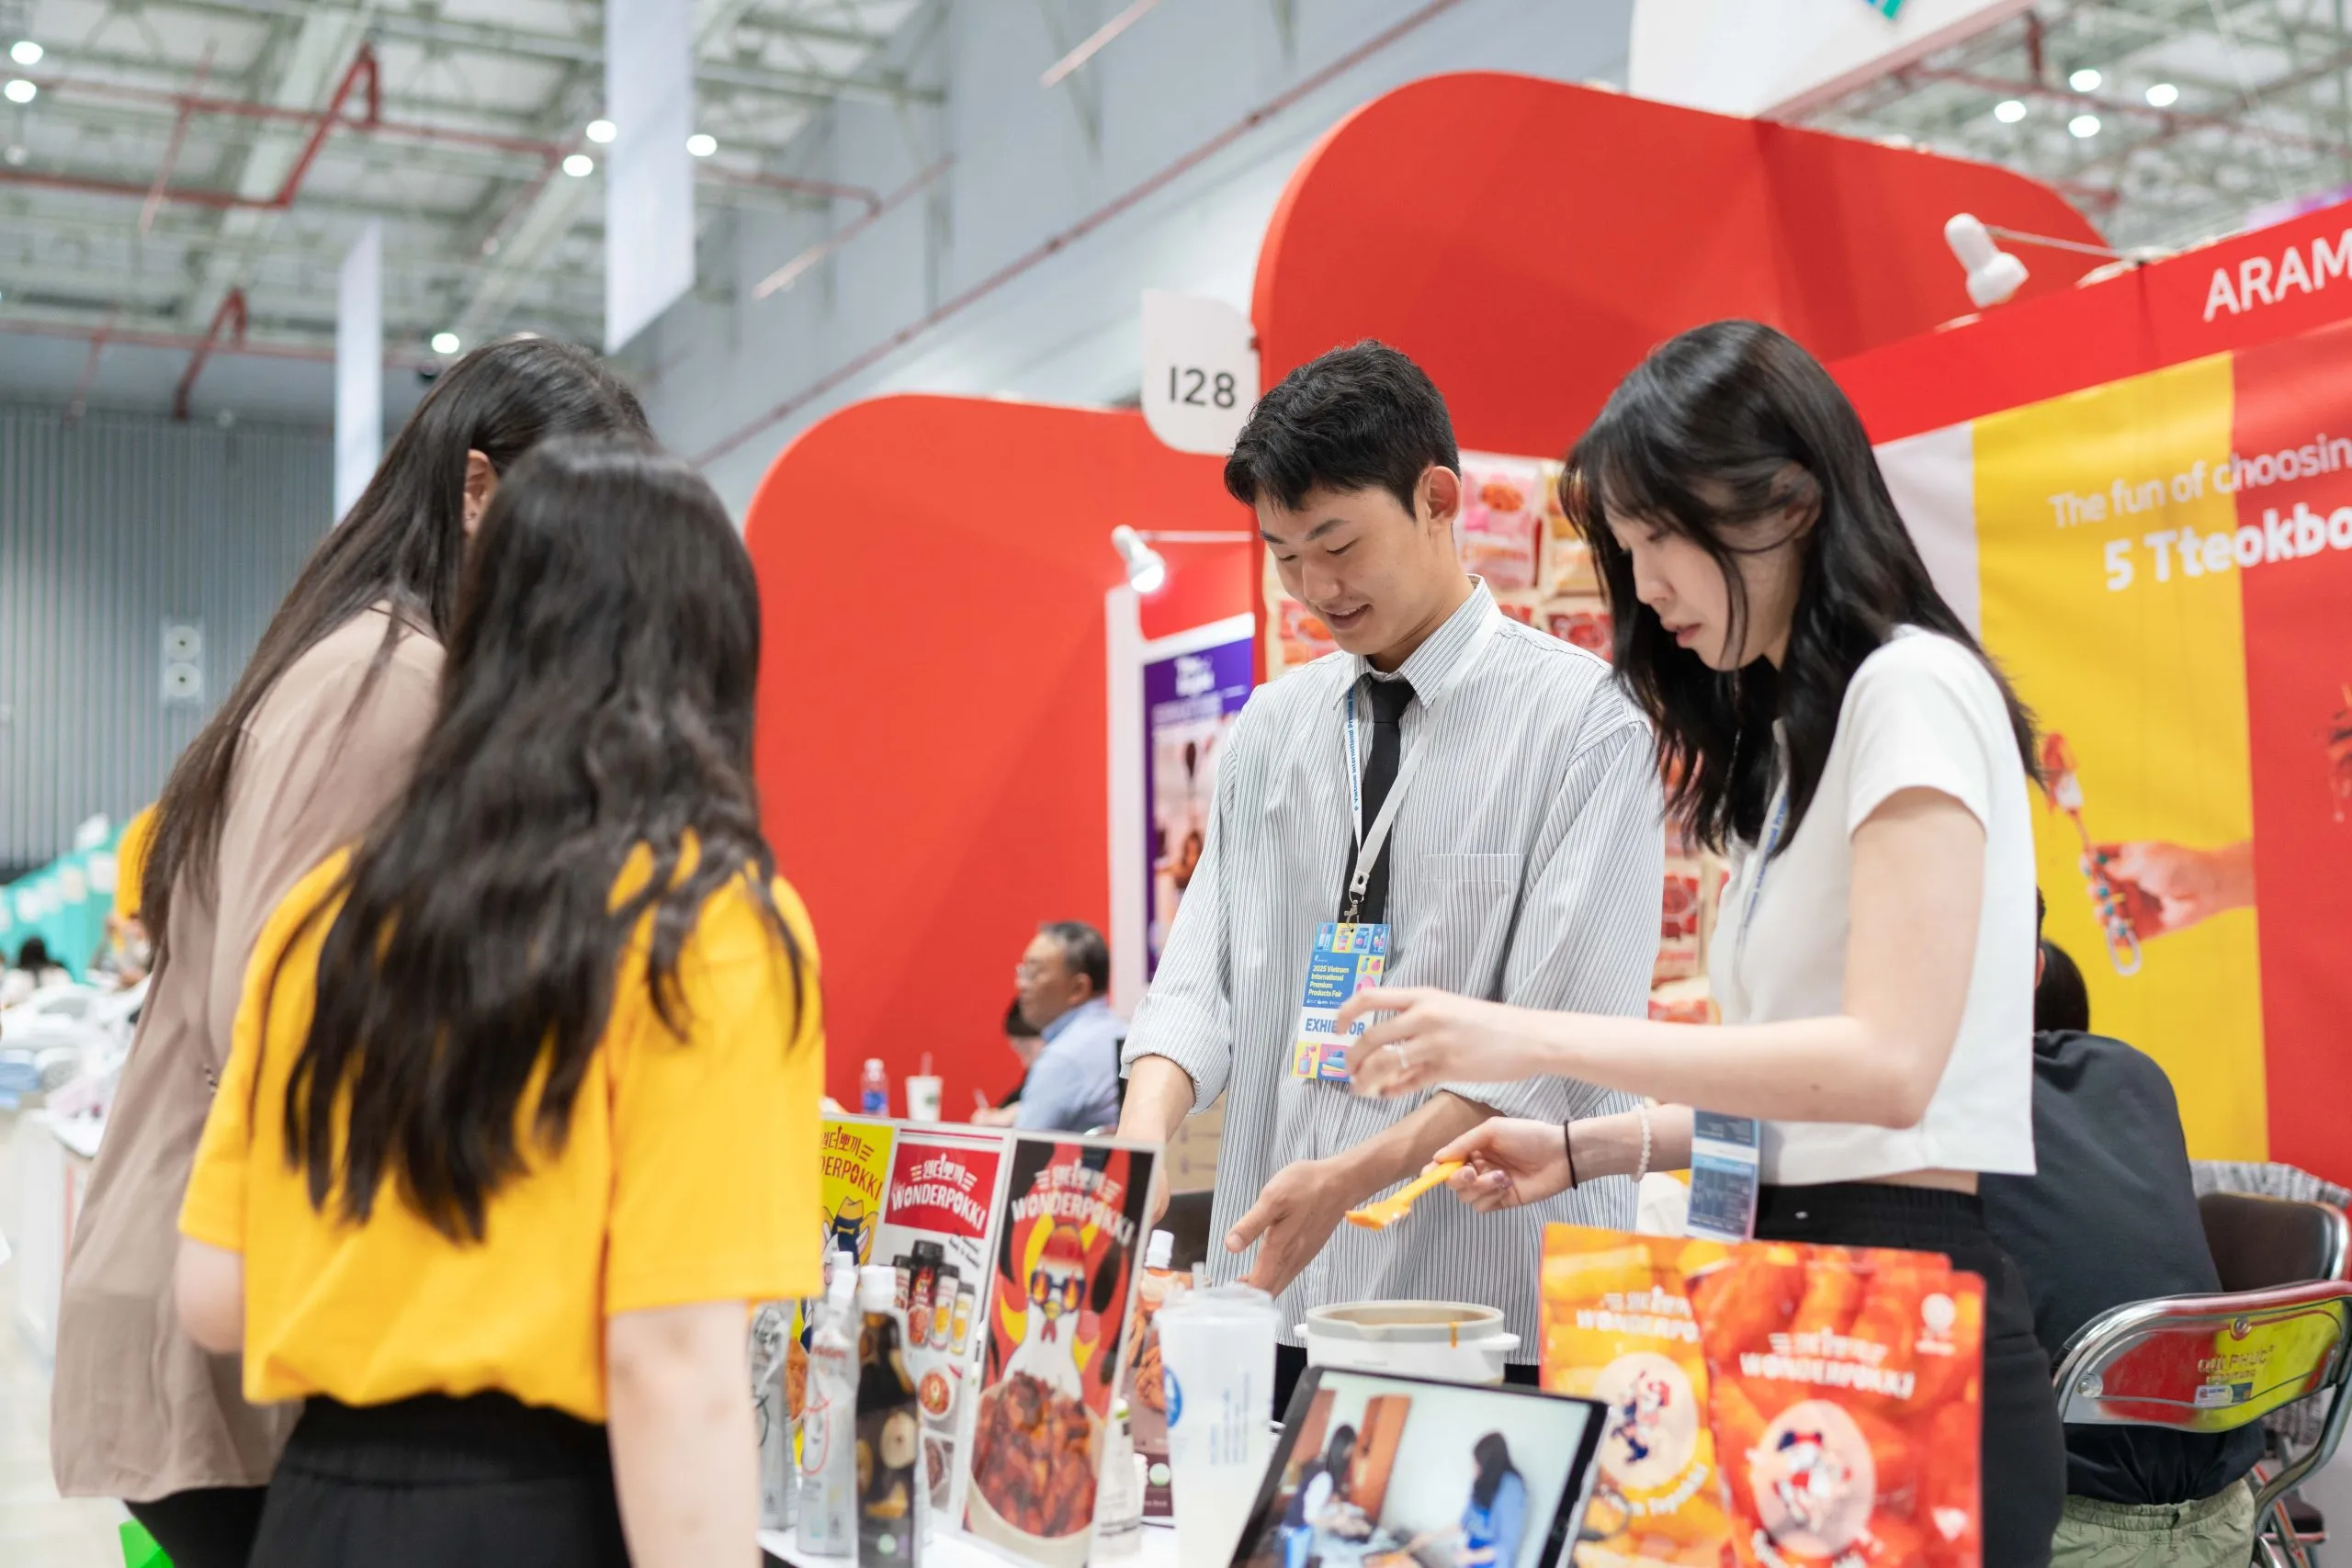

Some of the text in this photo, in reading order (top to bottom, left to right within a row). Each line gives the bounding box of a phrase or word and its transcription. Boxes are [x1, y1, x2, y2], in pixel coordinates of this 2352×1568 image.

[2203, 228, 2352, 321] ARAM
[2048, 434, 2352, 528] The fun of choosin
[2104, 502, 2352, 592] 5 Tteokbo
[1307, 988, 1343, 998] Products Fair
[1311, 973, 1344, 982] International
[1327, 965, 1350, 974] Vietnam
[1305, 1018, 1365, 1036] EXHIBOR
[892, 1183, 986, 1232] WONDERPOKKI
[1012, 1190, 1136, 1247] WONDERPOKKI
[1739, 1351, 1916, 1400] WONDERPOKKI
